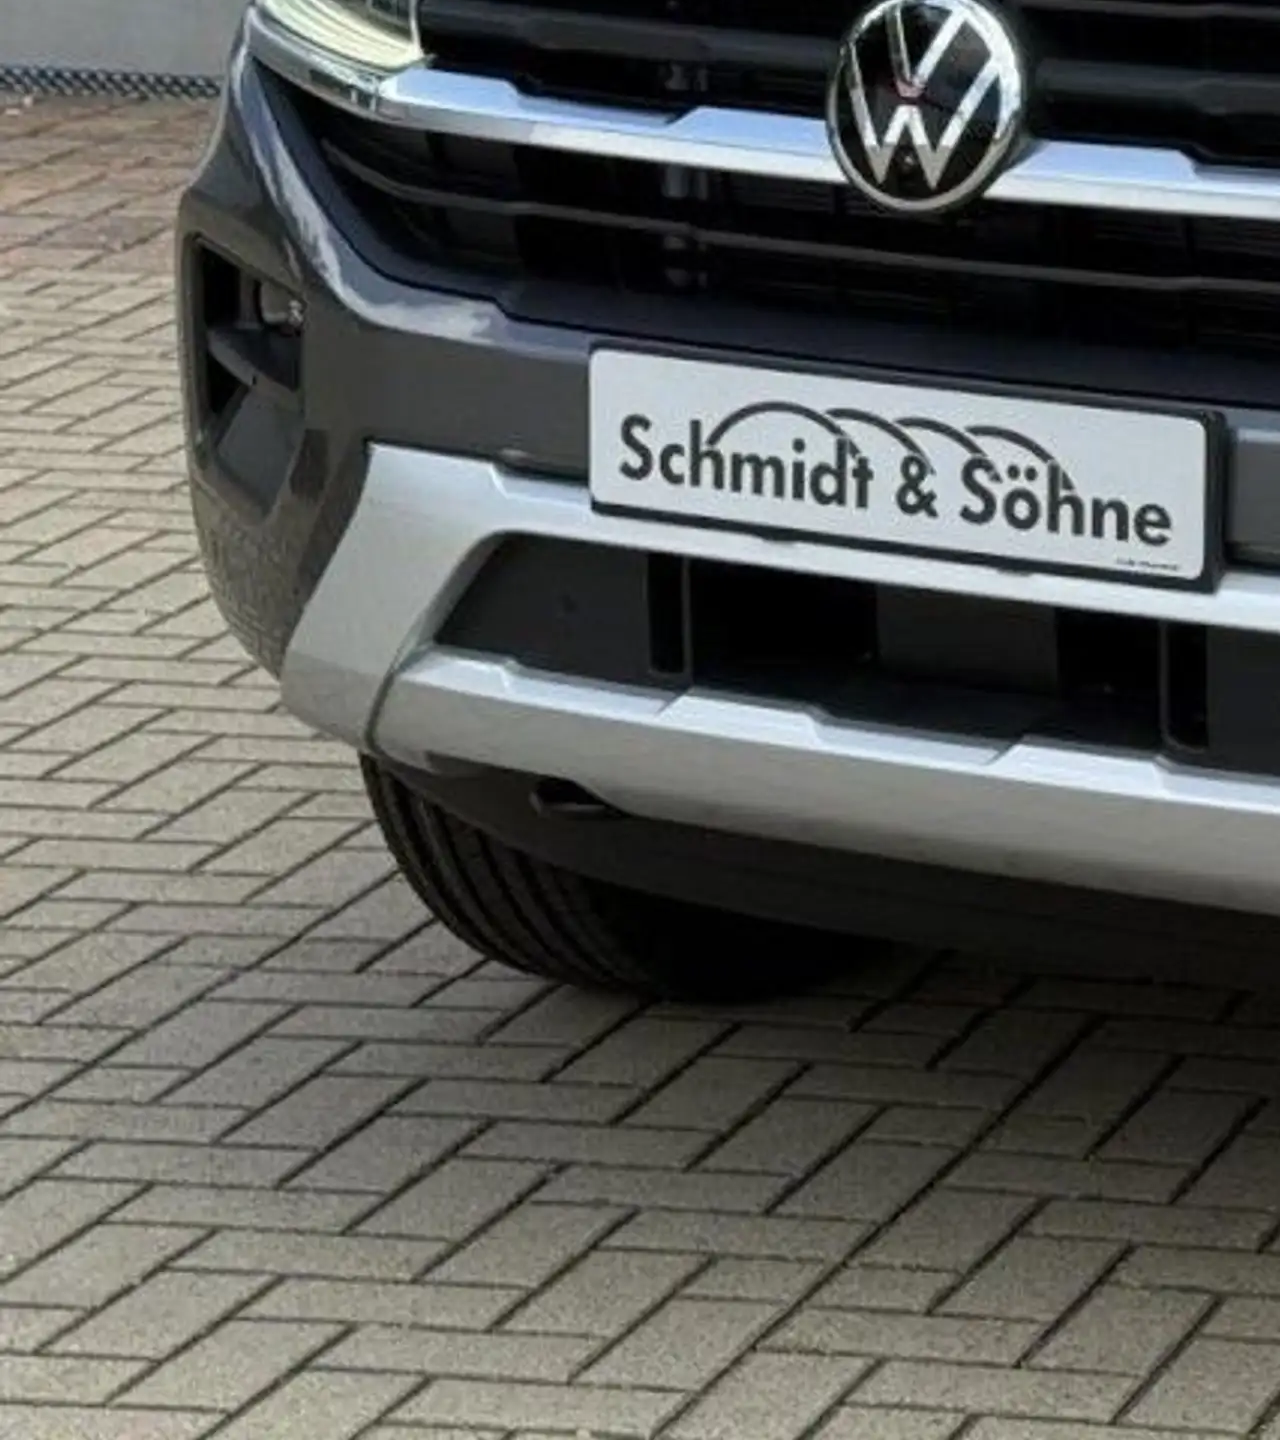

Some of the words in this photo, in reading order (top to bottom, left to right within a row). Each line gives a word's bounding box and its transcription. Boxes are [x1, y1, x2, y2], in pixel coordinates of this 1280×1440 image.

[618, 413, 873, 509] Schmidt
[895, 453, 938, 518] &
[958, 455, 1172, 547] Söhne
